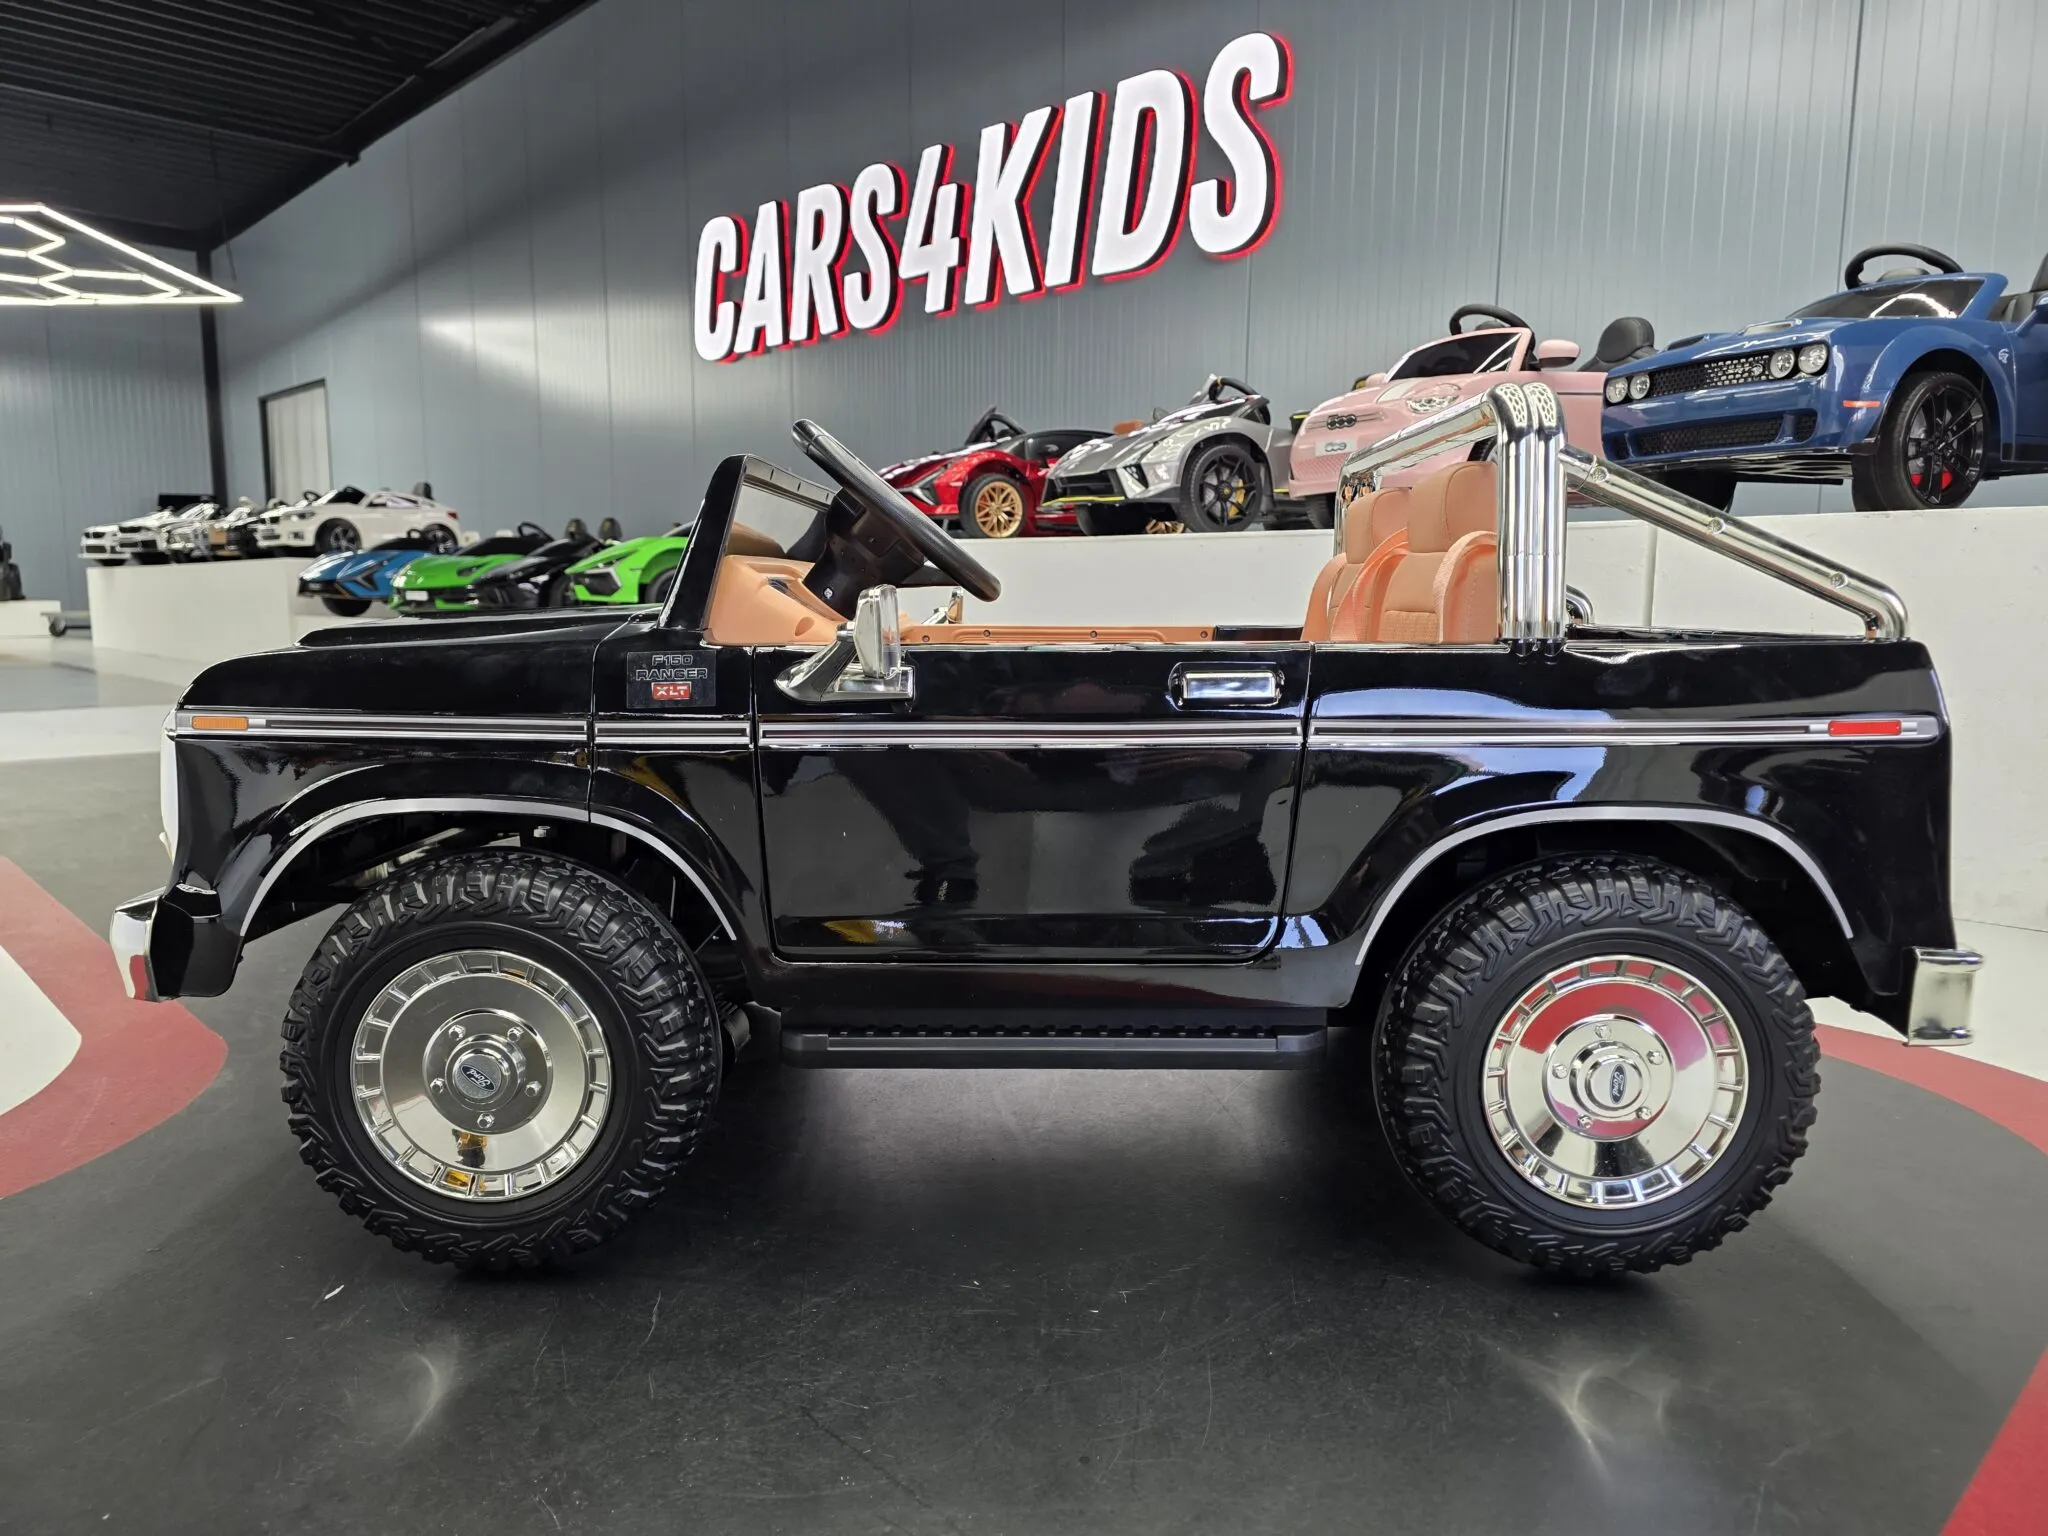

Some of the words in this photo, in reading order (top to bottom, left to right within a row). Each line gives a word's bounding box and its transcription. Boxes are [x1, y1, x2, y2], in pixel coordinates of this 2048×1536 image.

[694, 31, 1288, 362] CARS4KIDS
[651, 654, 694, 666] F150
[635, 667, 708, 681] RANGER
[656, 685, 689, 696] XLT
[465, 1068, 492, 1088] Ford
[1612, 1071, 1625, 1097] Ford
